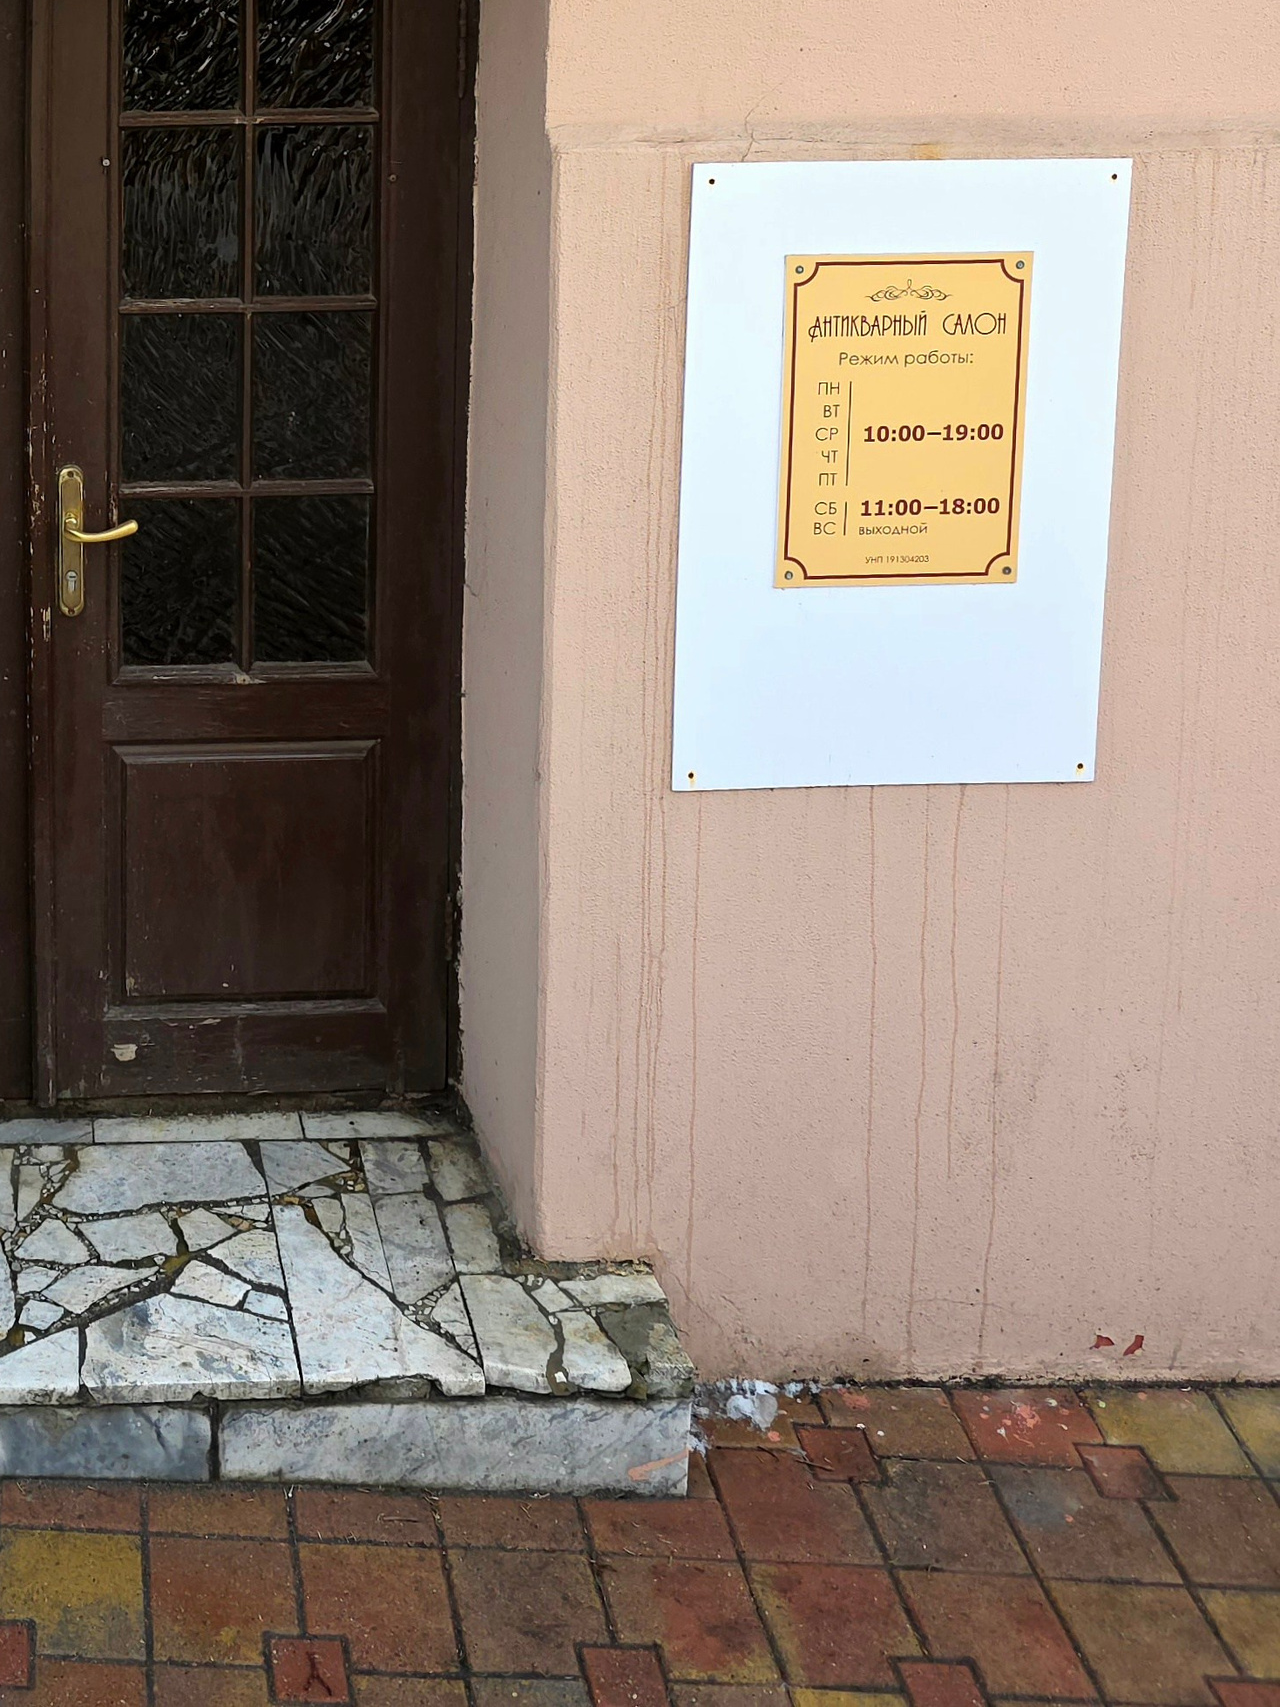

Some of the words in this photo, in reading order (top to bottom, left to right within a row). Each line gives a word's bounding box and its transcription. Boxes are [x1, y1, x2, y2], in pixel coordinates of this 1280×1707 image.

[808, 311, 927, 342] АНТИКВАРНЫЙ
[943, 313, 1006, 335] САЛОН
[839, 352, 898, 365] Режим
[905, 350, 973, 367] работы:
[818, 382, 839, 395] ПН
[824, 405, 840, 418] ВТ
[816, 428, 838, 441] СР
[822, 450, 838, 463] ЧТ
[819, 473, 837, 486] ПТ
[815, 502, 837, 515] СБ
[814, 522, 836, 535] ВС
[859, 523, 927, 535] выходной
[866, 556, 883, 564] УНП
